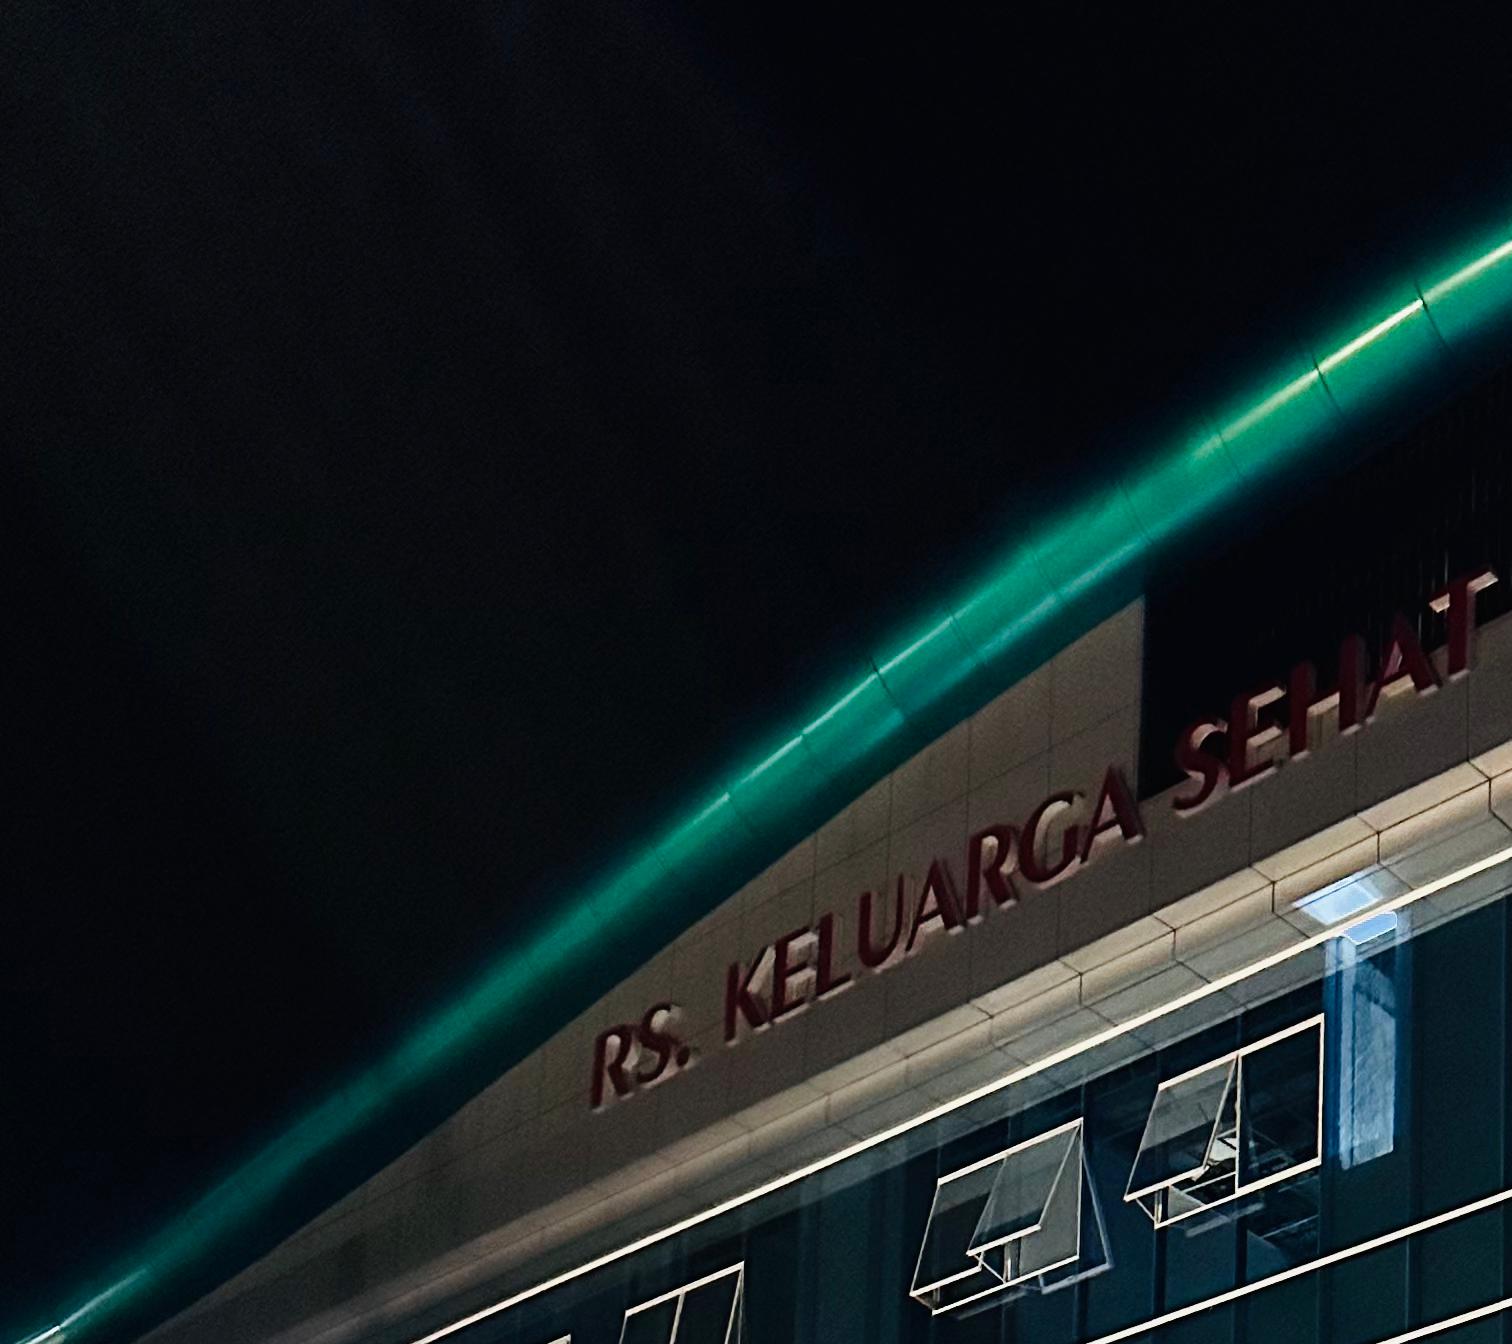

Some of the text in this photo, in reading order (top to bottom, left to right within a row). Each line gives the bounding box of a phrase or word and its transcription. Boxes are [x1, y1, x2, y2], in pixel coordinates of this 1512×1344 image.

[590, 567, 1498, 1112] RS. KELUARGA SEHAT
